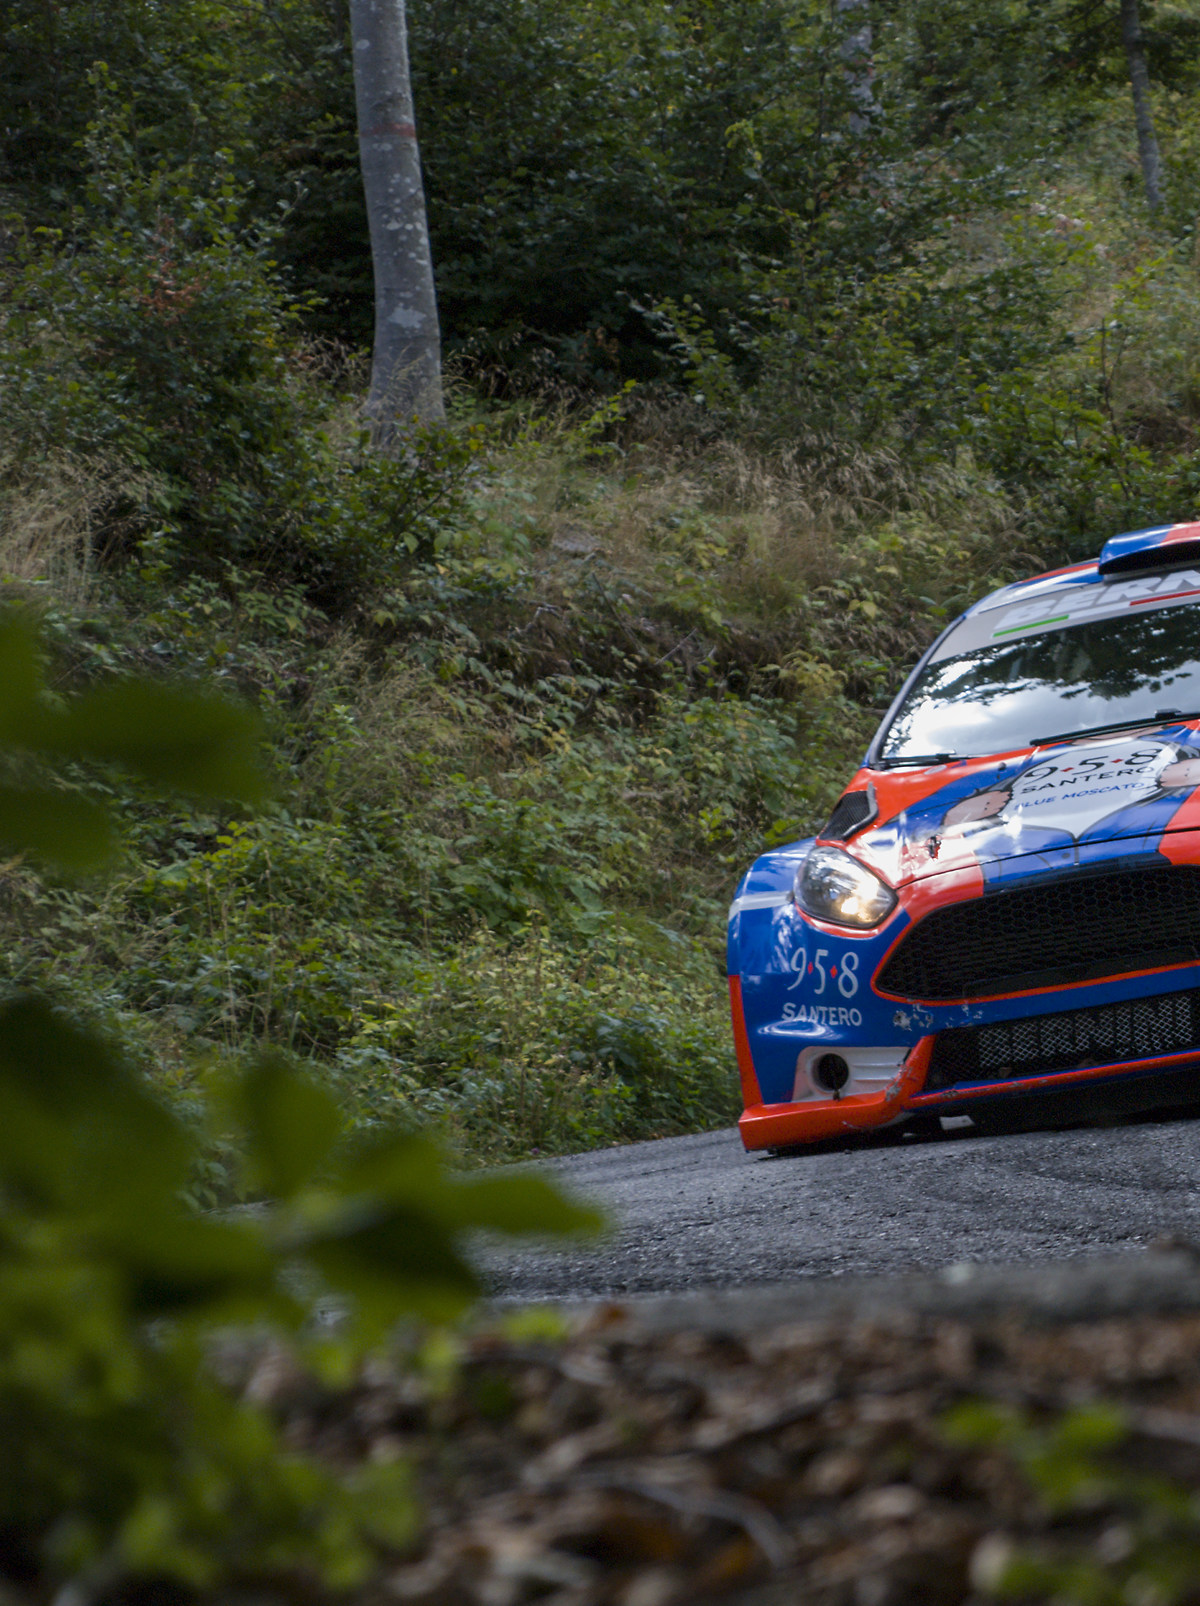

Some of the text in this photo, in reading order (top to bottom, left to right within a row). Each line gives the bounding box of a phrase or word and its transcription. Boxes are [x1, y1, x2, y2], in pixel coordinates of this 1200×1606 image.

[1021, 766, 1154, 794] SANTERO
[1062, 782, 1144, 801] MOSCATO
[781, 1002, 862, 1027] SANTERO
[977, 995, 1193, 1068] BERNINI
